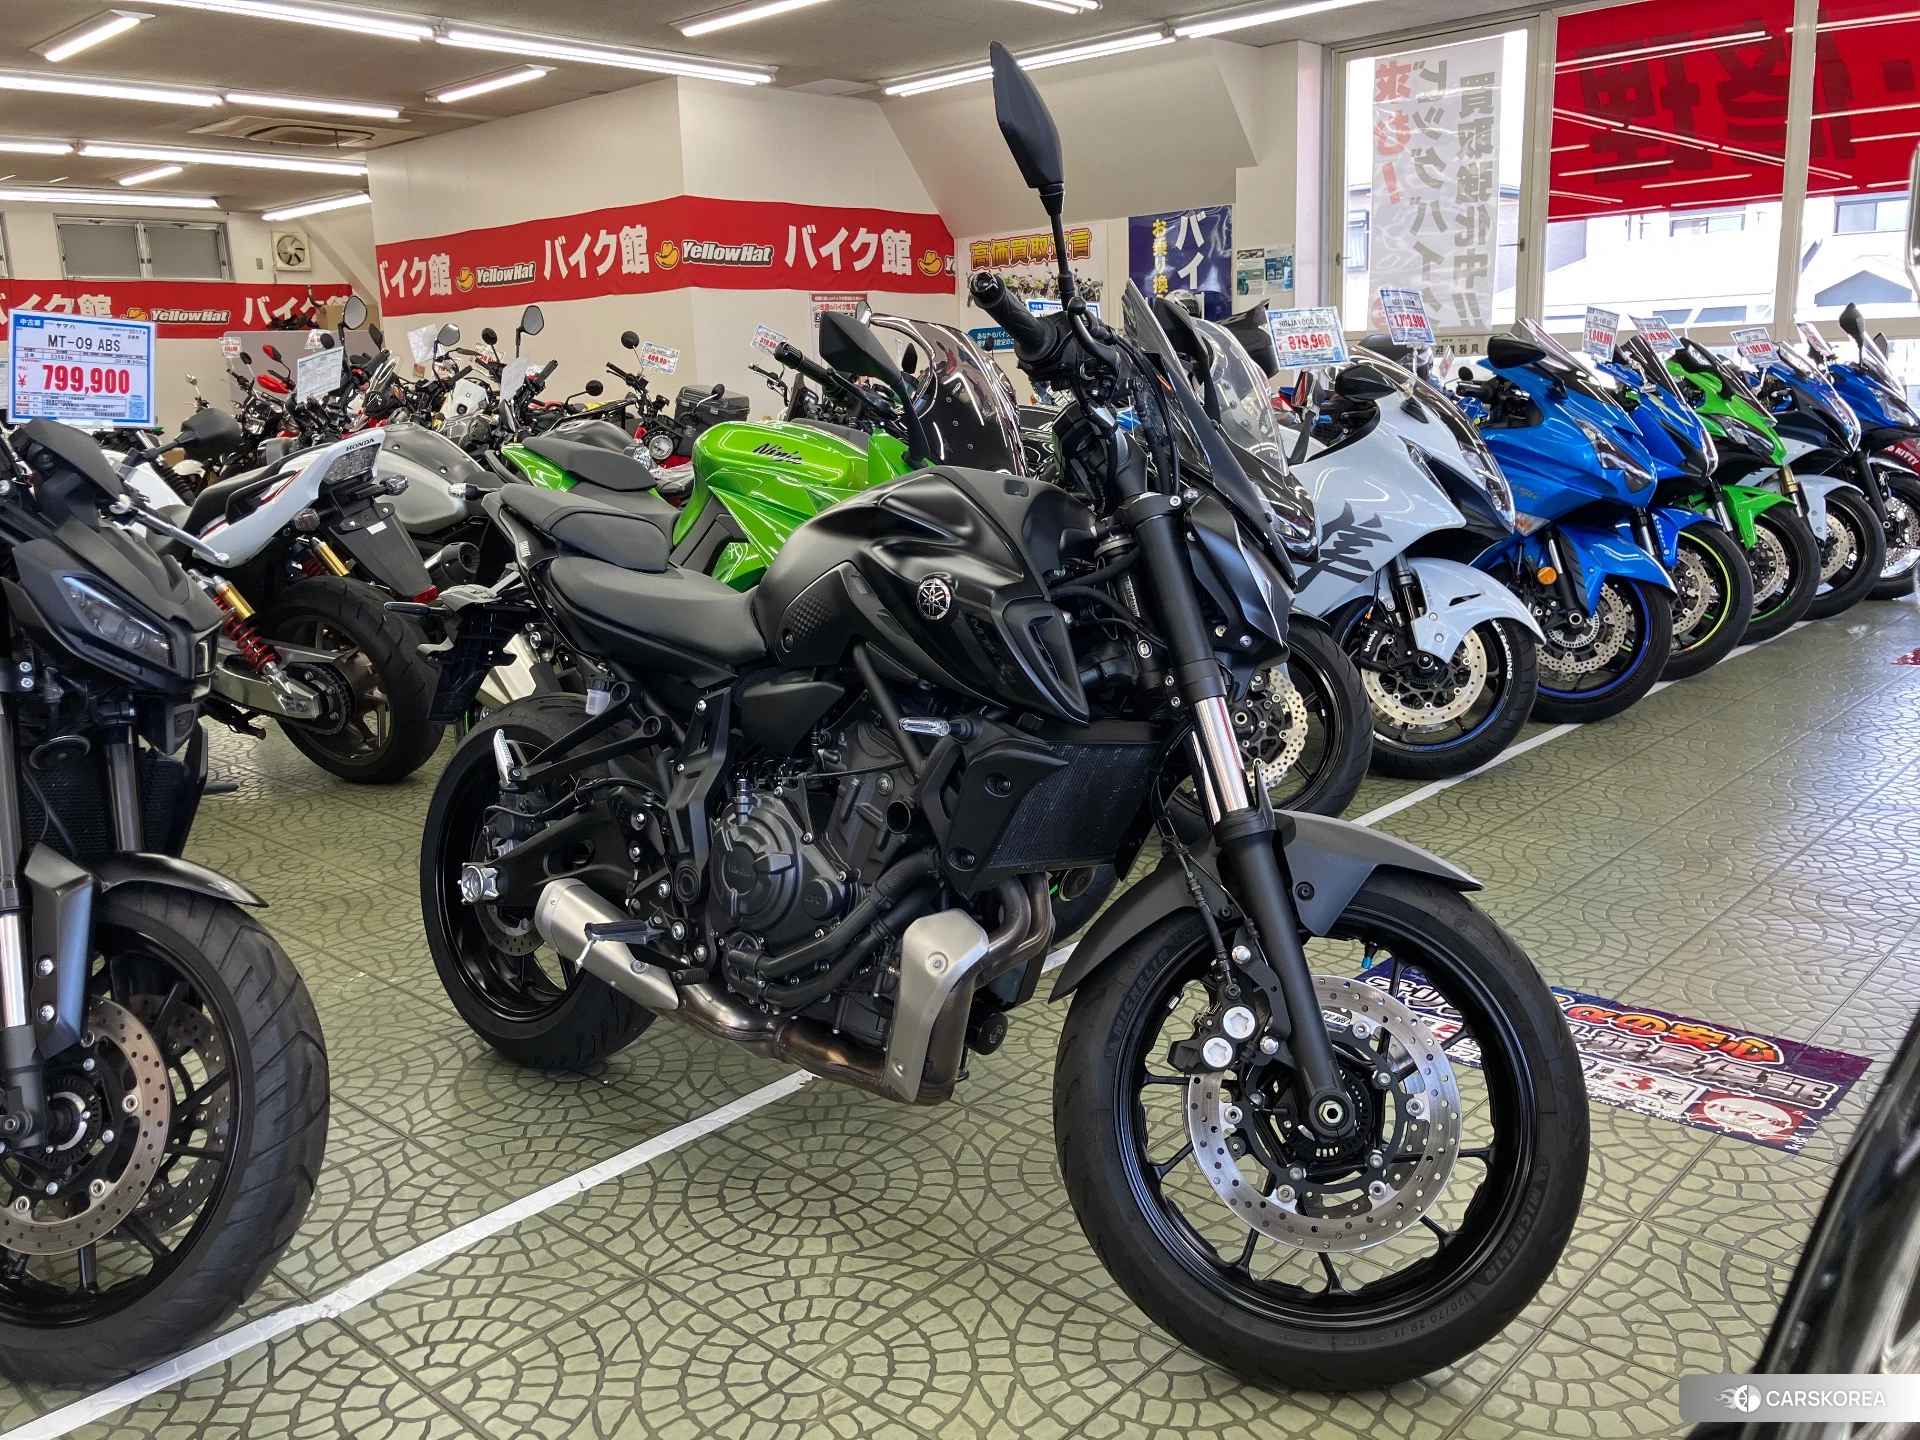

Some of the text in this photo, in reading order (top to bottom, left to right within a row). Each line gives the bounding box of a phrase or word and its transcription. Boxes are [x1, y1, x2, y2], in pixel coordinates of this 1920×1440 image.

[544, 225, 650, 280] バイク館
[682, 241, 772, 263] YellowHat
[785, 224, 912, 275] バイク館
[1153, 219, 1168, 300] お乗り換
[476, 263, 535, 285] YellowHat
[19, 318, 41, 327] 中古車
[151, 309, 230, 323] YellowHat
[47, 334, 93, 350] MT-09
[97, 338, 121, 352] ABS
[18, 374, 27, 388] ¥
[42, 364, 130, 395] 799,900
[346, 438, 375, 452] HONDA
[753, 442, 803, 465] Ninja
[1364, 630, 1379, 652] brembo
[1500, 634, 1513, 680] RACING
[1485, 1187, 1543, 1282] MICHELIN
[1430, 1294, 1471, 1324] 120/70
[1394, 1328, 1406, 1338] 17
[1410, 1320, 1427, 1332] ZR
